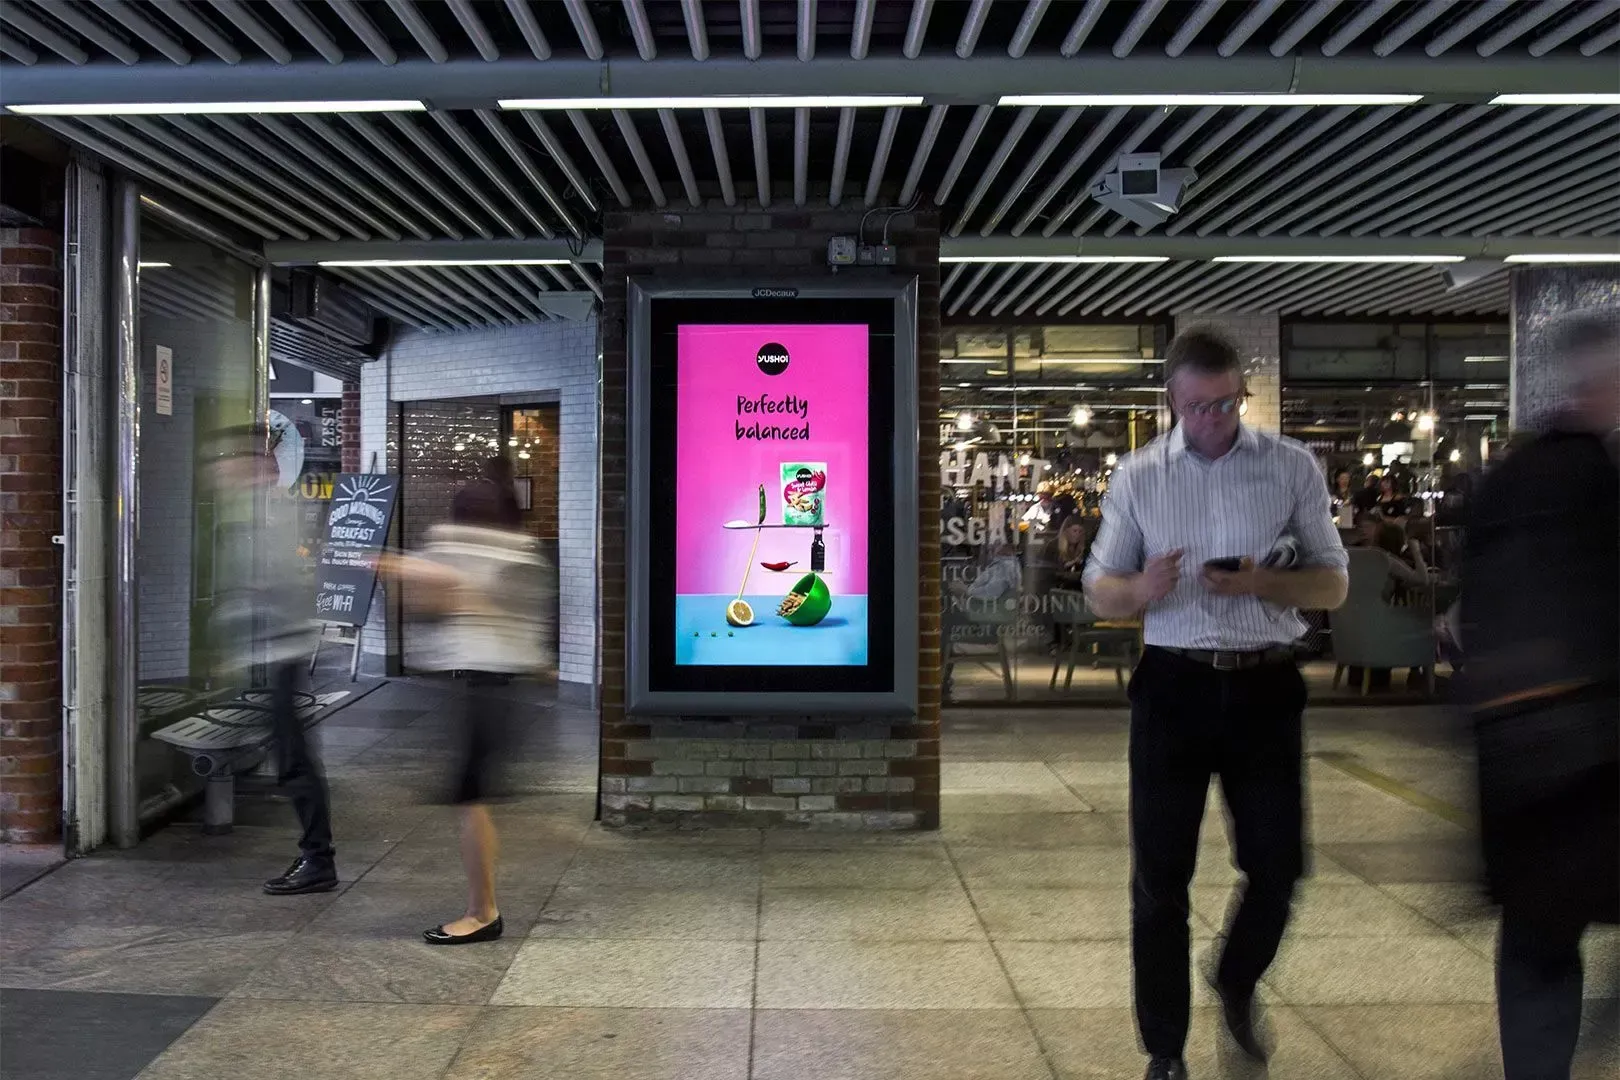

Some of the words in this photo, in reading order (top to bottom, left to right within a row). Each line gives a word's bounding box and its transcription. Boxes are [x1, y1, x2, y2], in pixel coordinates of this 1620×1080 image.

[754, 288, 796, 298] JCDecaux
[736, 393, 809, 420] Perfectly
[321, 407, 335, 447] ZEST
[735, 419, 810, 441] balanced
[329, 503, 350, 526] GOOD
[331, 526, 376, 541] BREAKFAST
